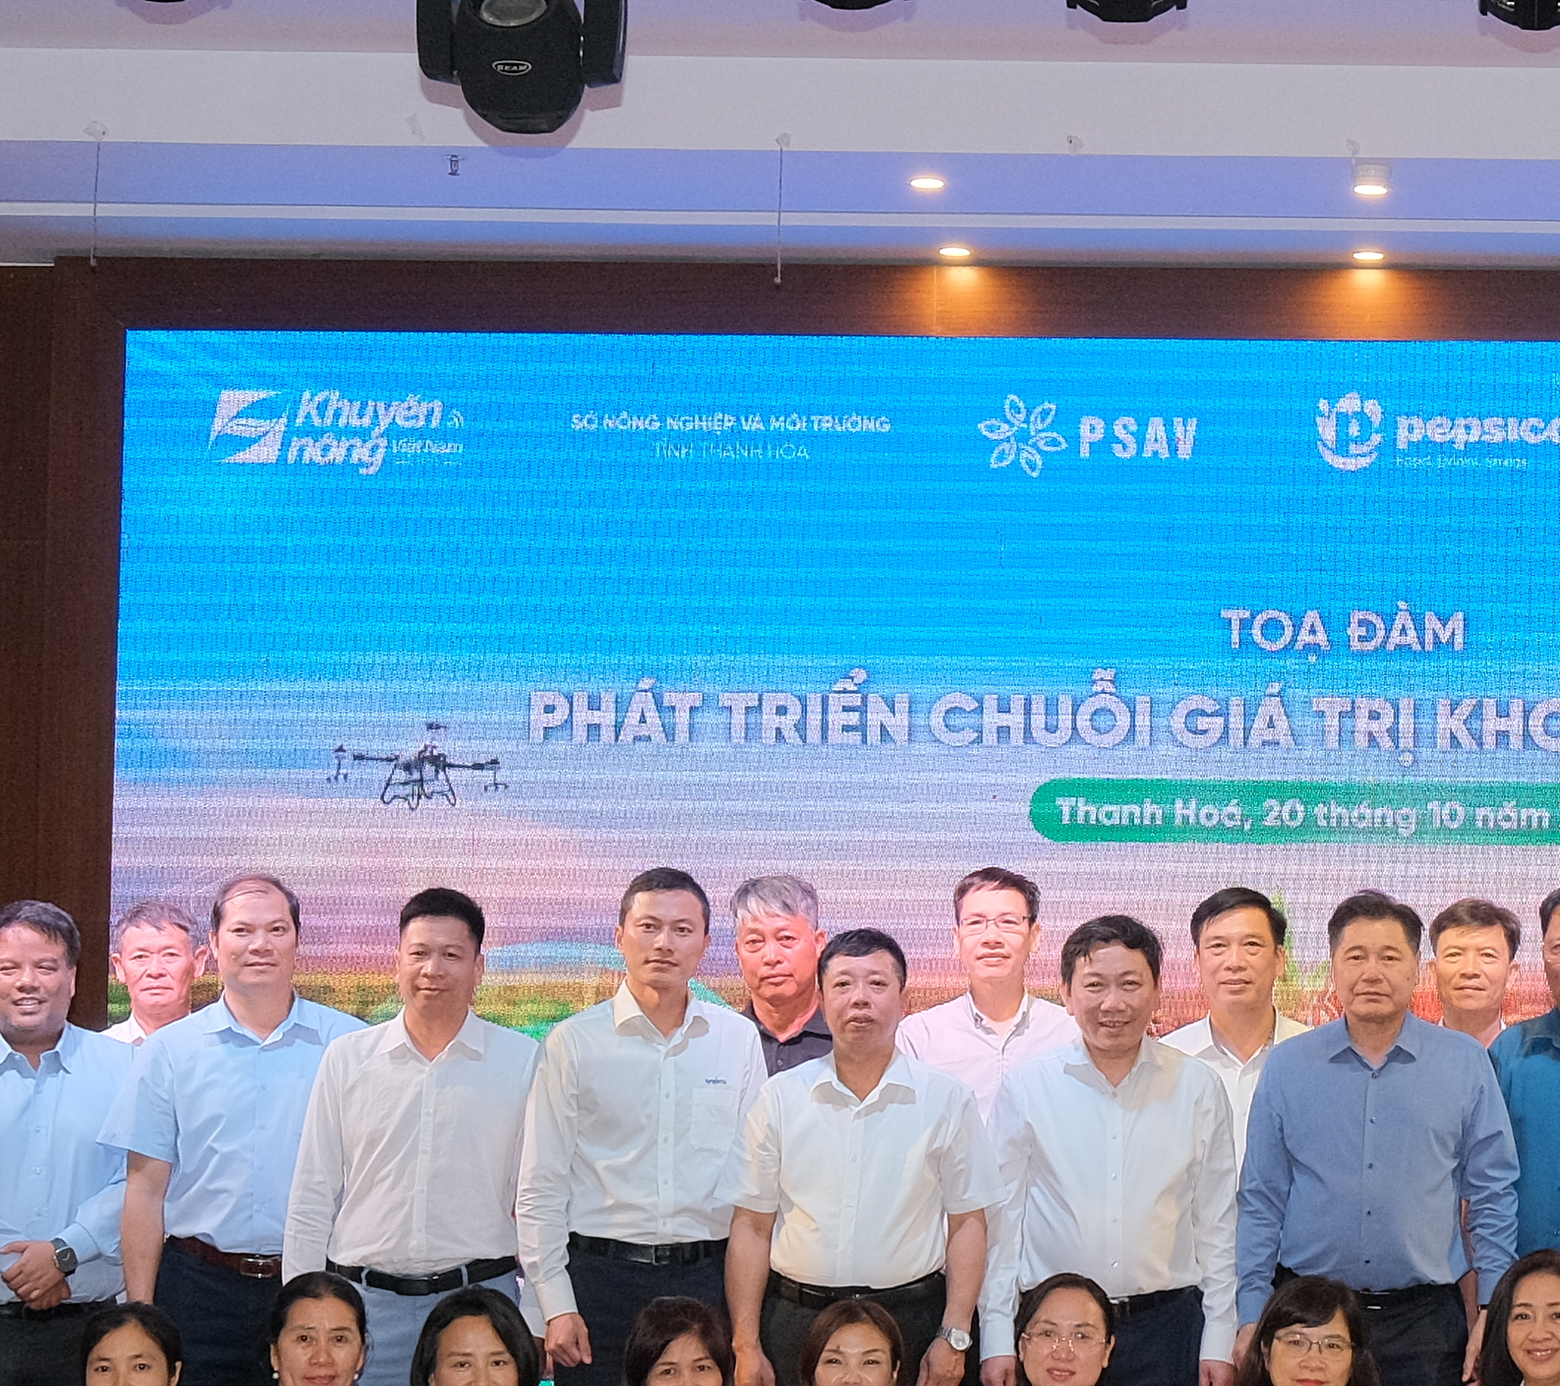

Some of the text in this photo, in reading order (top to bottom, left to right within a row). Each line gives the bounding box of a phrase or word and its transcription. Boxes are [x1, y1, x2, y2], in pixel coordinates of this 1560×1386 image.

[287, 432, 388, 475] nông
[1080, 415, 1198, 459] PSAV
[1220, 600, 1466, 662] TOẠ ĐÀM
[528, 678, 704, 745] PHÁT
[720, 666, 911, 747] TRIỂN
[928, 666, 1152, 749] CHUỖI
[1169, 683, 1297, 751] GIÁ
[1312, 695, 1418, 767] TRỊ
[1055, 795, 1163, 827] Thanh
[1173, 793, 1252, 834] Hoá,
[1263, 800, 1306, 828] 20
[1314, 797, 1417, 837] tháng
[1428, 800, 1461, 829] 10
[1474, 796, 1551, 830] năm
